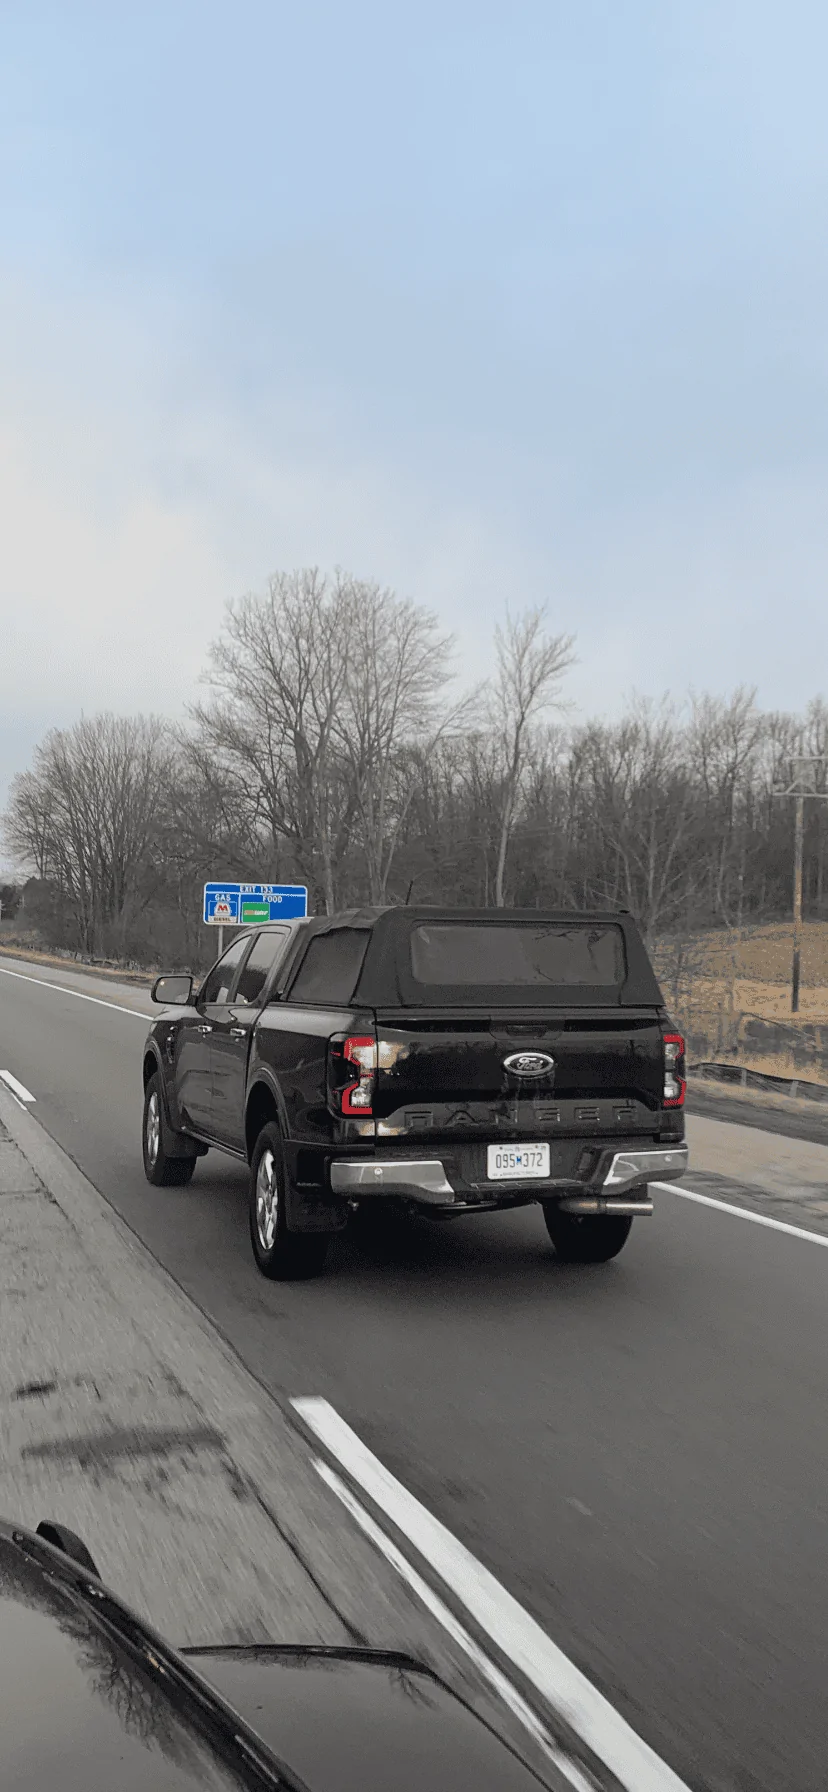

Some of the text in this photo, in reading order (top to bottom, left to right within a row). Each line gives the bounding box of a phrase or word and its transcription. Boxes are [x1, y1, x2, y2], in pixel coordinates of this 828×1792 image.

[240, 885, 256, 893] EXIT
[262, 895, 283, 903] FOOD
[403, 1104, 638, 1128] RANGER
